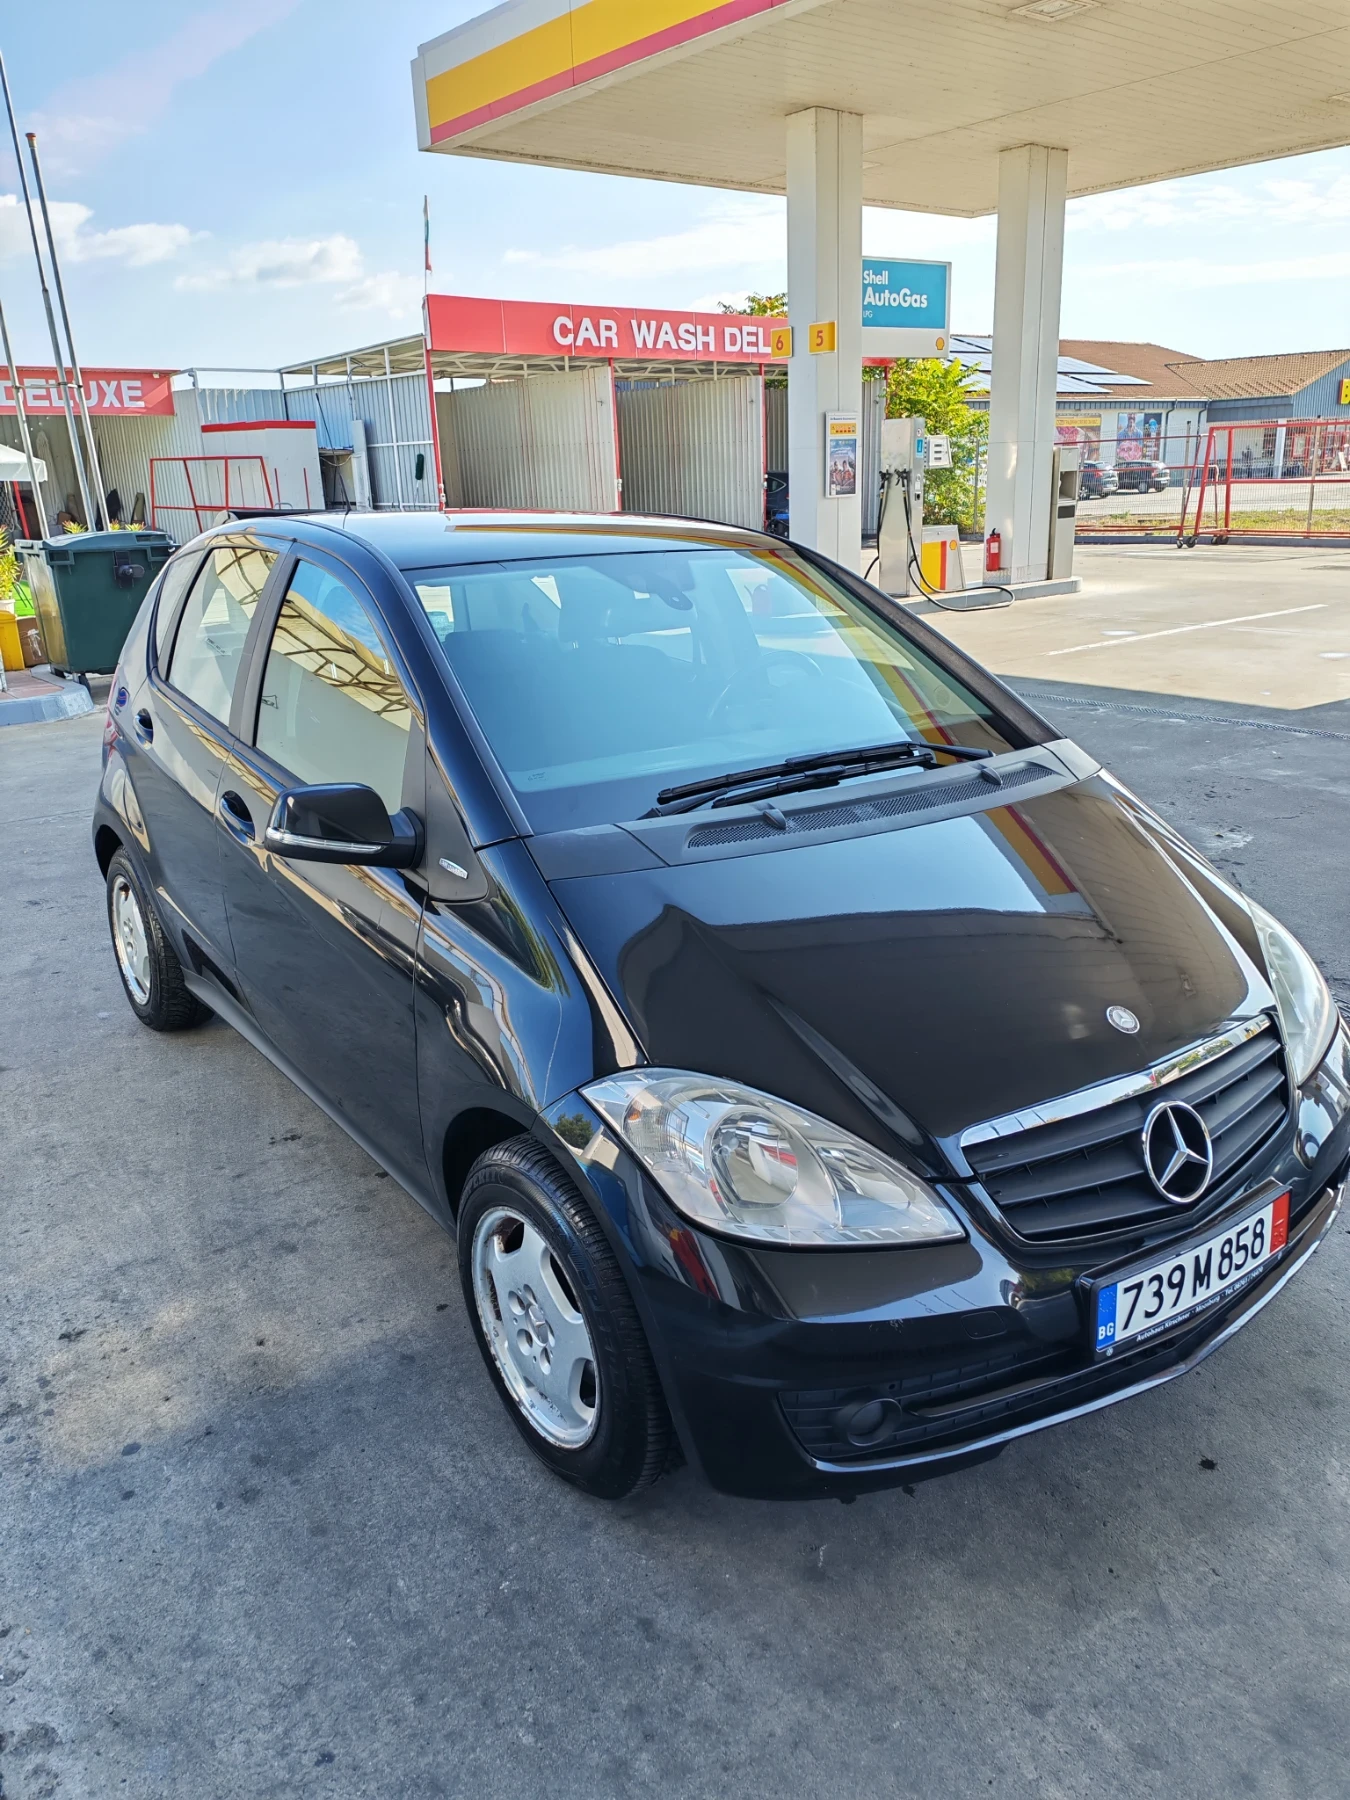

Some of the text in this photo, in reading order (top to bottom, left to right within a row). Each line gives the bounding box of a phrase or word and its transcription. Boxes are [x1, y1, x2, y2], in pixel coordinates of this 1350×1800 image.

[863, 270, 889, 285] Shell
[863, 286, 928, 308] AutoGas
[862, 310, 873, 318] LPG
[553, 315, 618, 348] CAR
[631, 319, 715, 351] WASH
[815, 329, 824, 347] 5
[775, 334, 784, 351] 6
[1098, 1322, 1115, 1340] BG
